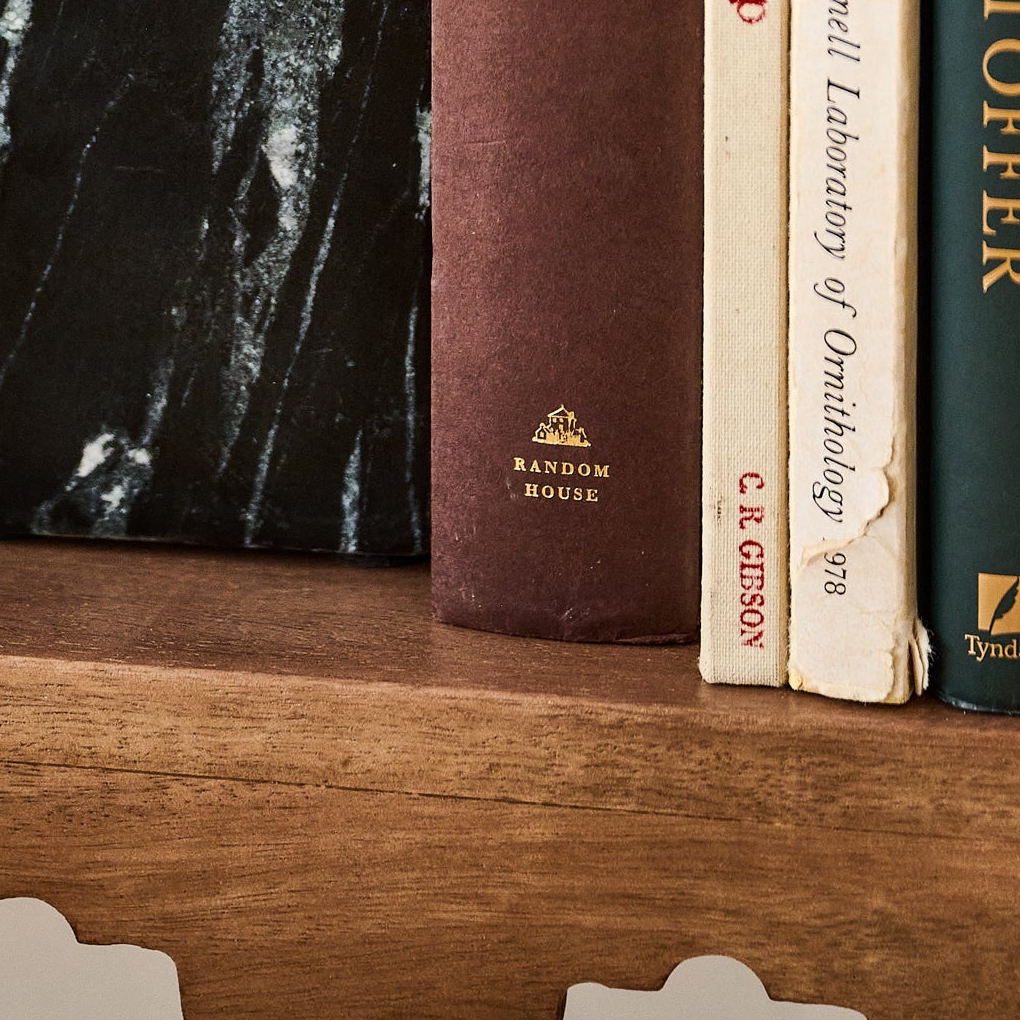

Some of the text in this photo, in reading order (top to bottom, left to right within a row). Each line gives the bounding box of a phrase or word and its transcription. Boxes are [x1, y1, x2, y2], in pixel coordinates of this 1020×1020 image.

[814, 76, 861, 260] Laboratory
[813, 276, 857, 319] of
[812, 328, 857, 523] Ornithology
[513, 457, 610, 478] RANDOM
[524, 483, 598, 502] HOUSE
[823, 537, 847, 595] 978
[739, 539, 765, 649] GIBSON
[964, 633, 1020, 662] Tynd
